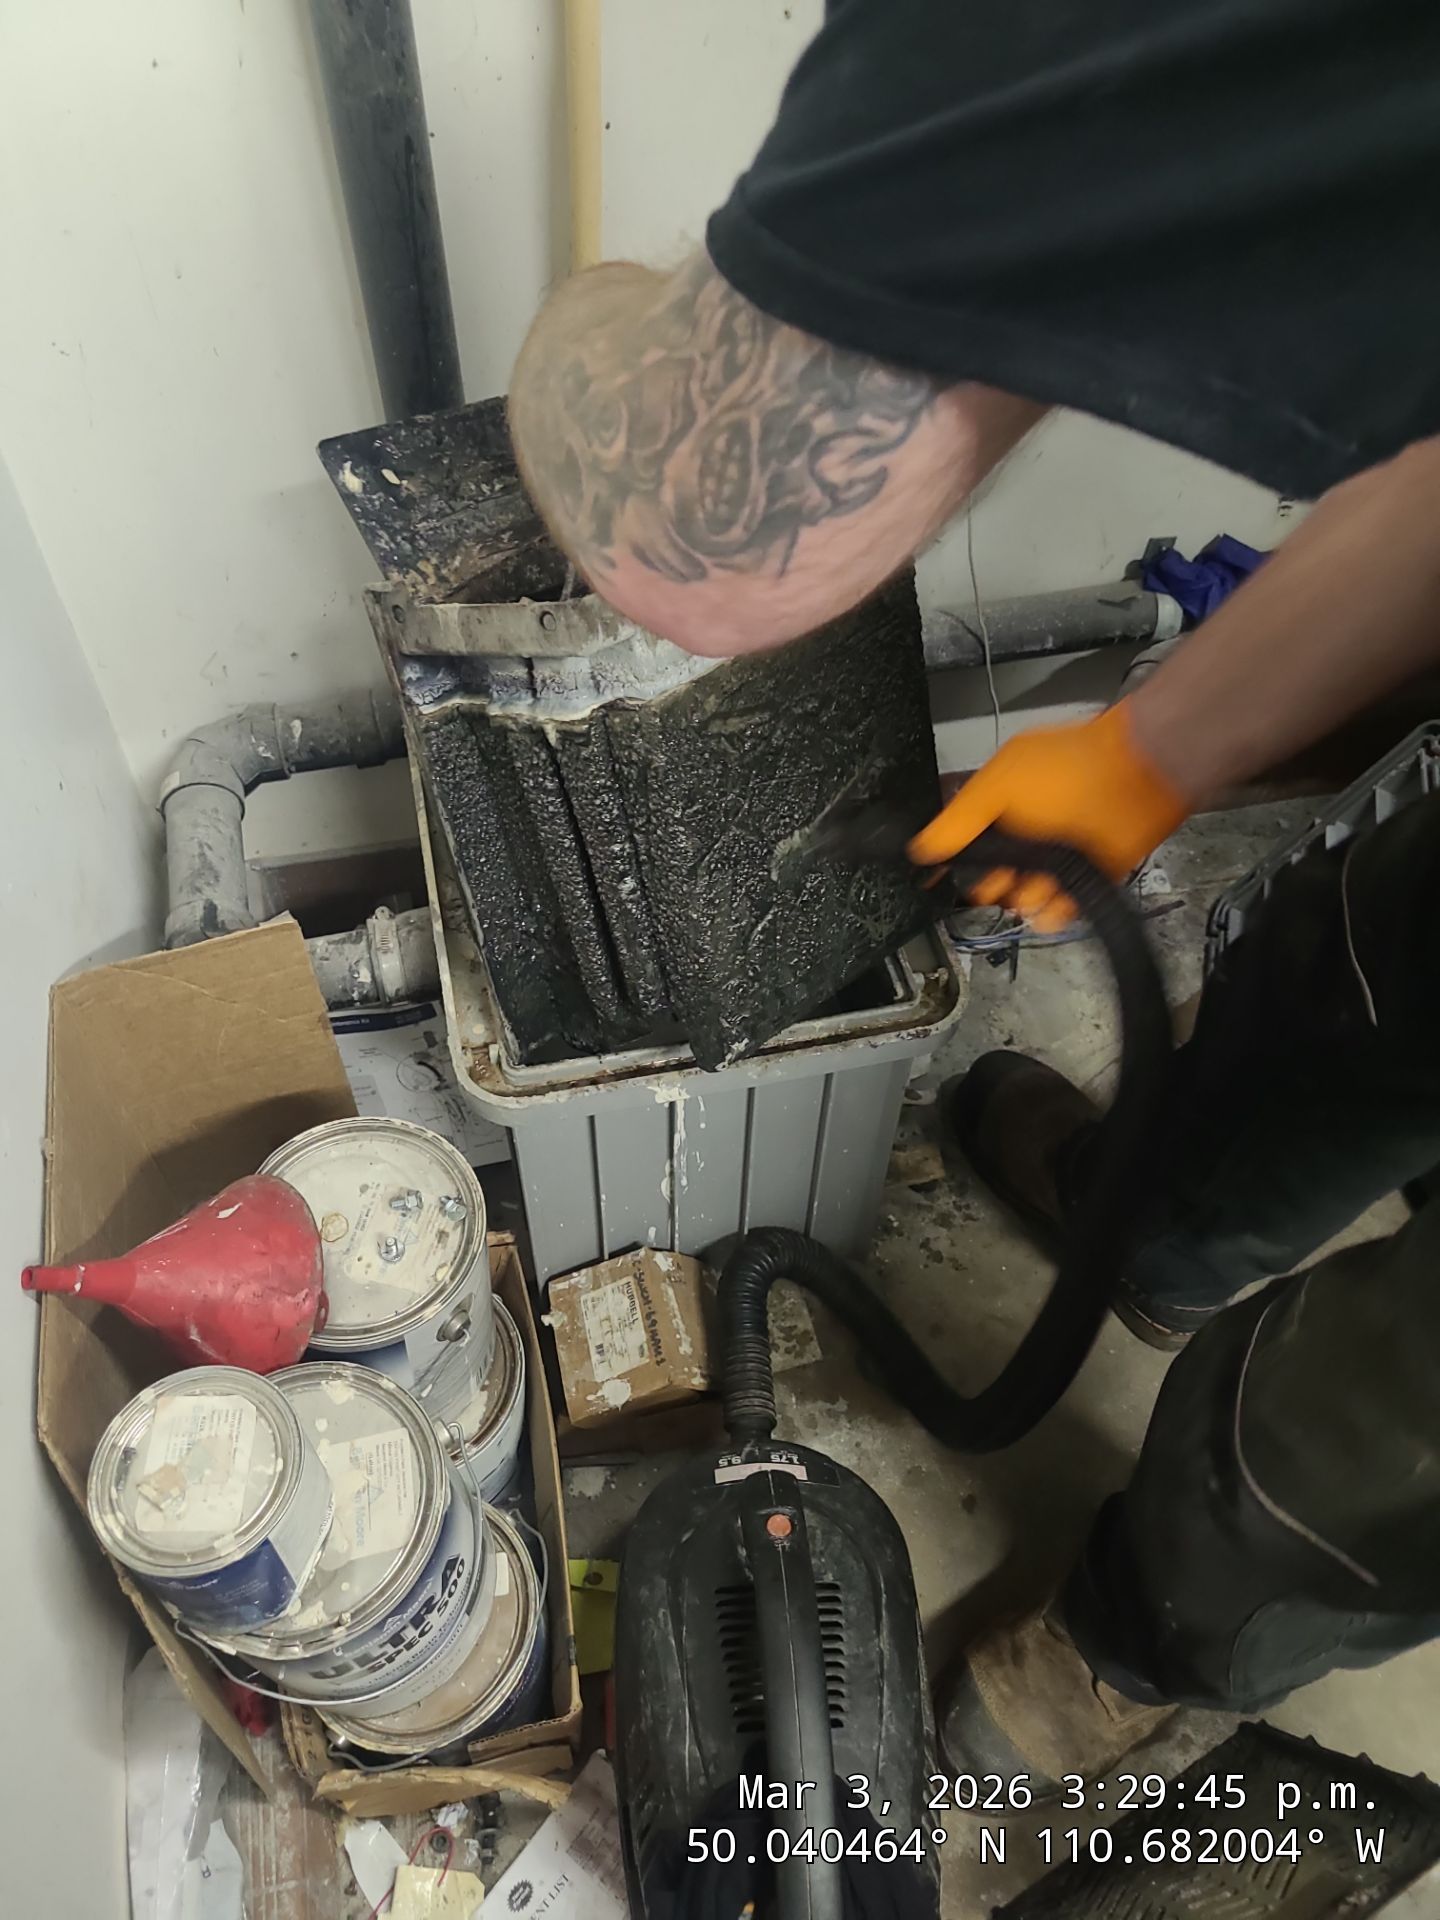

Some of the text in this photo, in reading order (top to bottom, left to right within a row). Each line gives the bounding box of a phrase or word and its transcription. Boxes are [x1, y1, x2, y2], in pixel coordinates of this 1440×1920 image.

[624, 1281, 640, 1325] HUBBELL
[718, 1455, 742, 1467] 9.5
[307, 1553, 461, 1680] ULTRA
[367, 1621, 434, 1674] SPEC
[436, 1558, 466, 1618] 500
[547, 1872, 569, 1901] LIST
